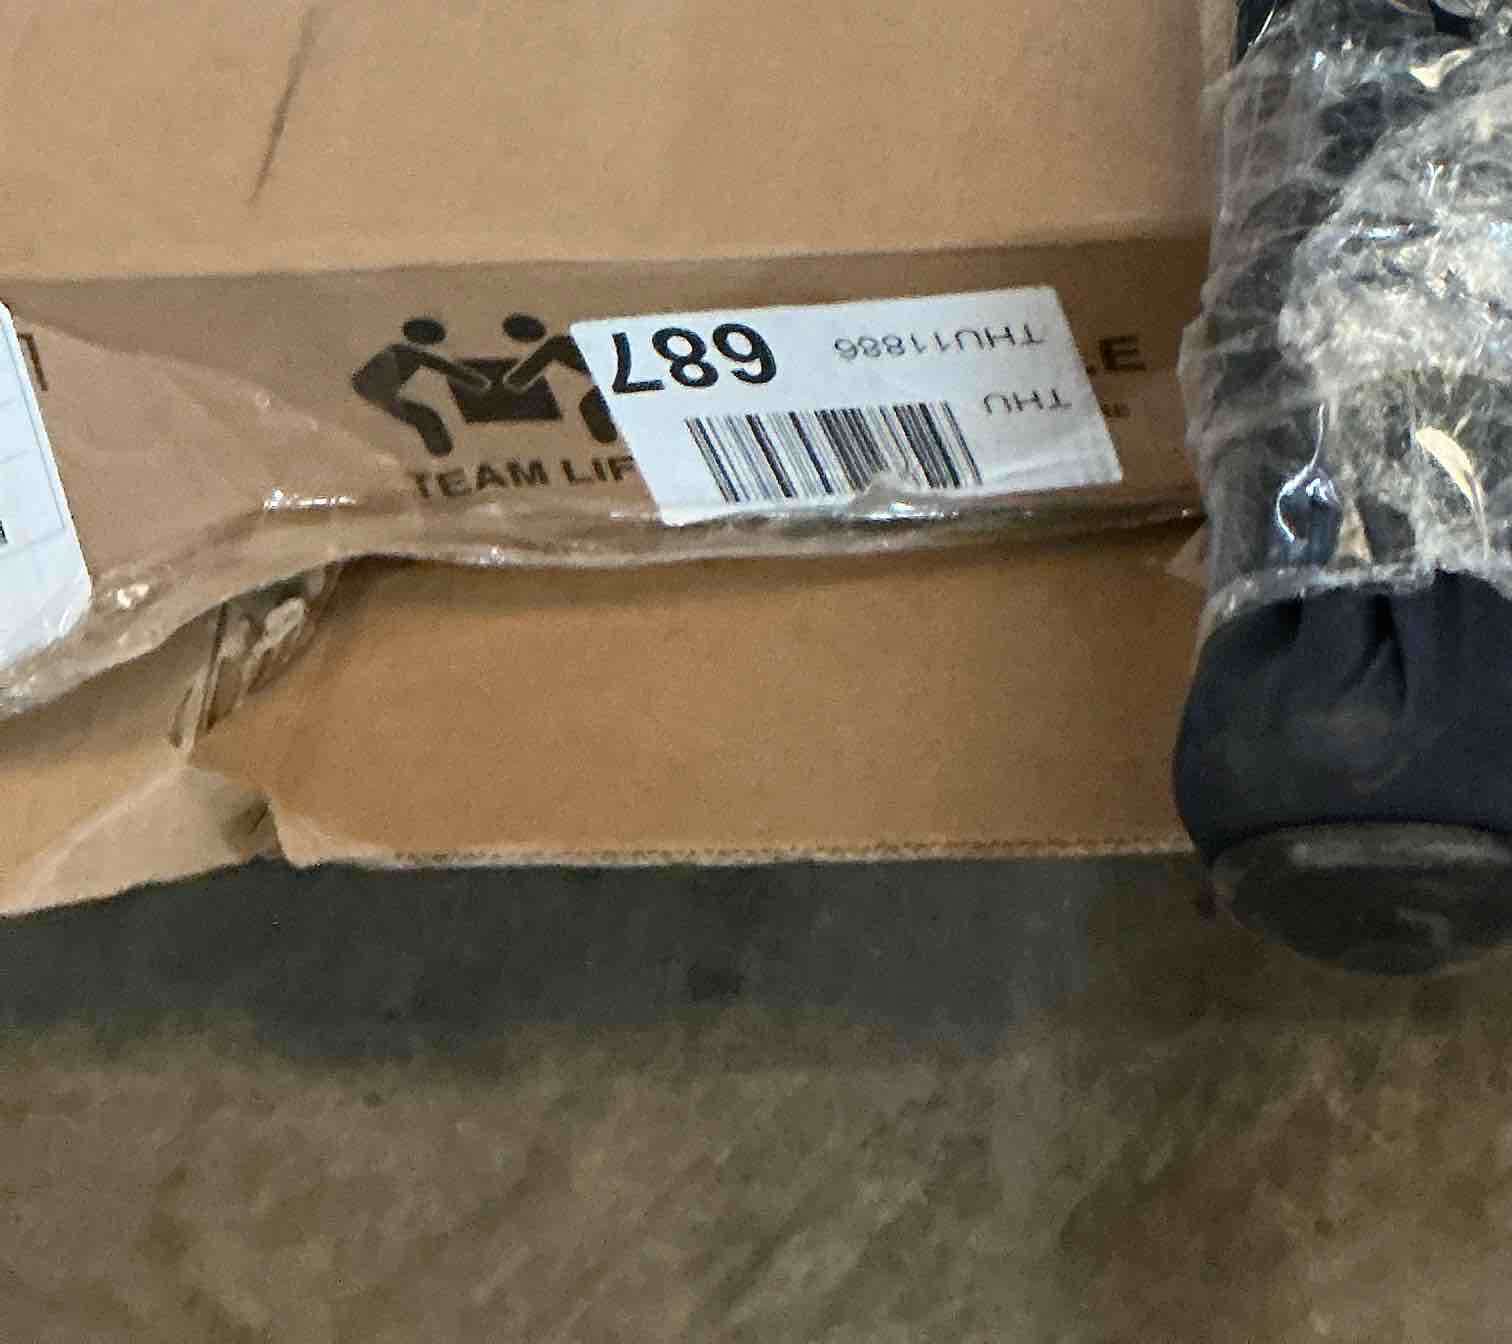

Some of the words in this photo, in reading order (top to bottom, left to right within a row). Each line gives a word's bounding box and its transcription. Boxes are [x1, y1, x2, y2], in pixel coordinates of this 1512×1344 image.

[608, 322, 779, 396] 687
[834, 322, 1045, 364] THU11886
[981, 389, 1072, 419] THU
[411, 457, 547, 502] TEAM
